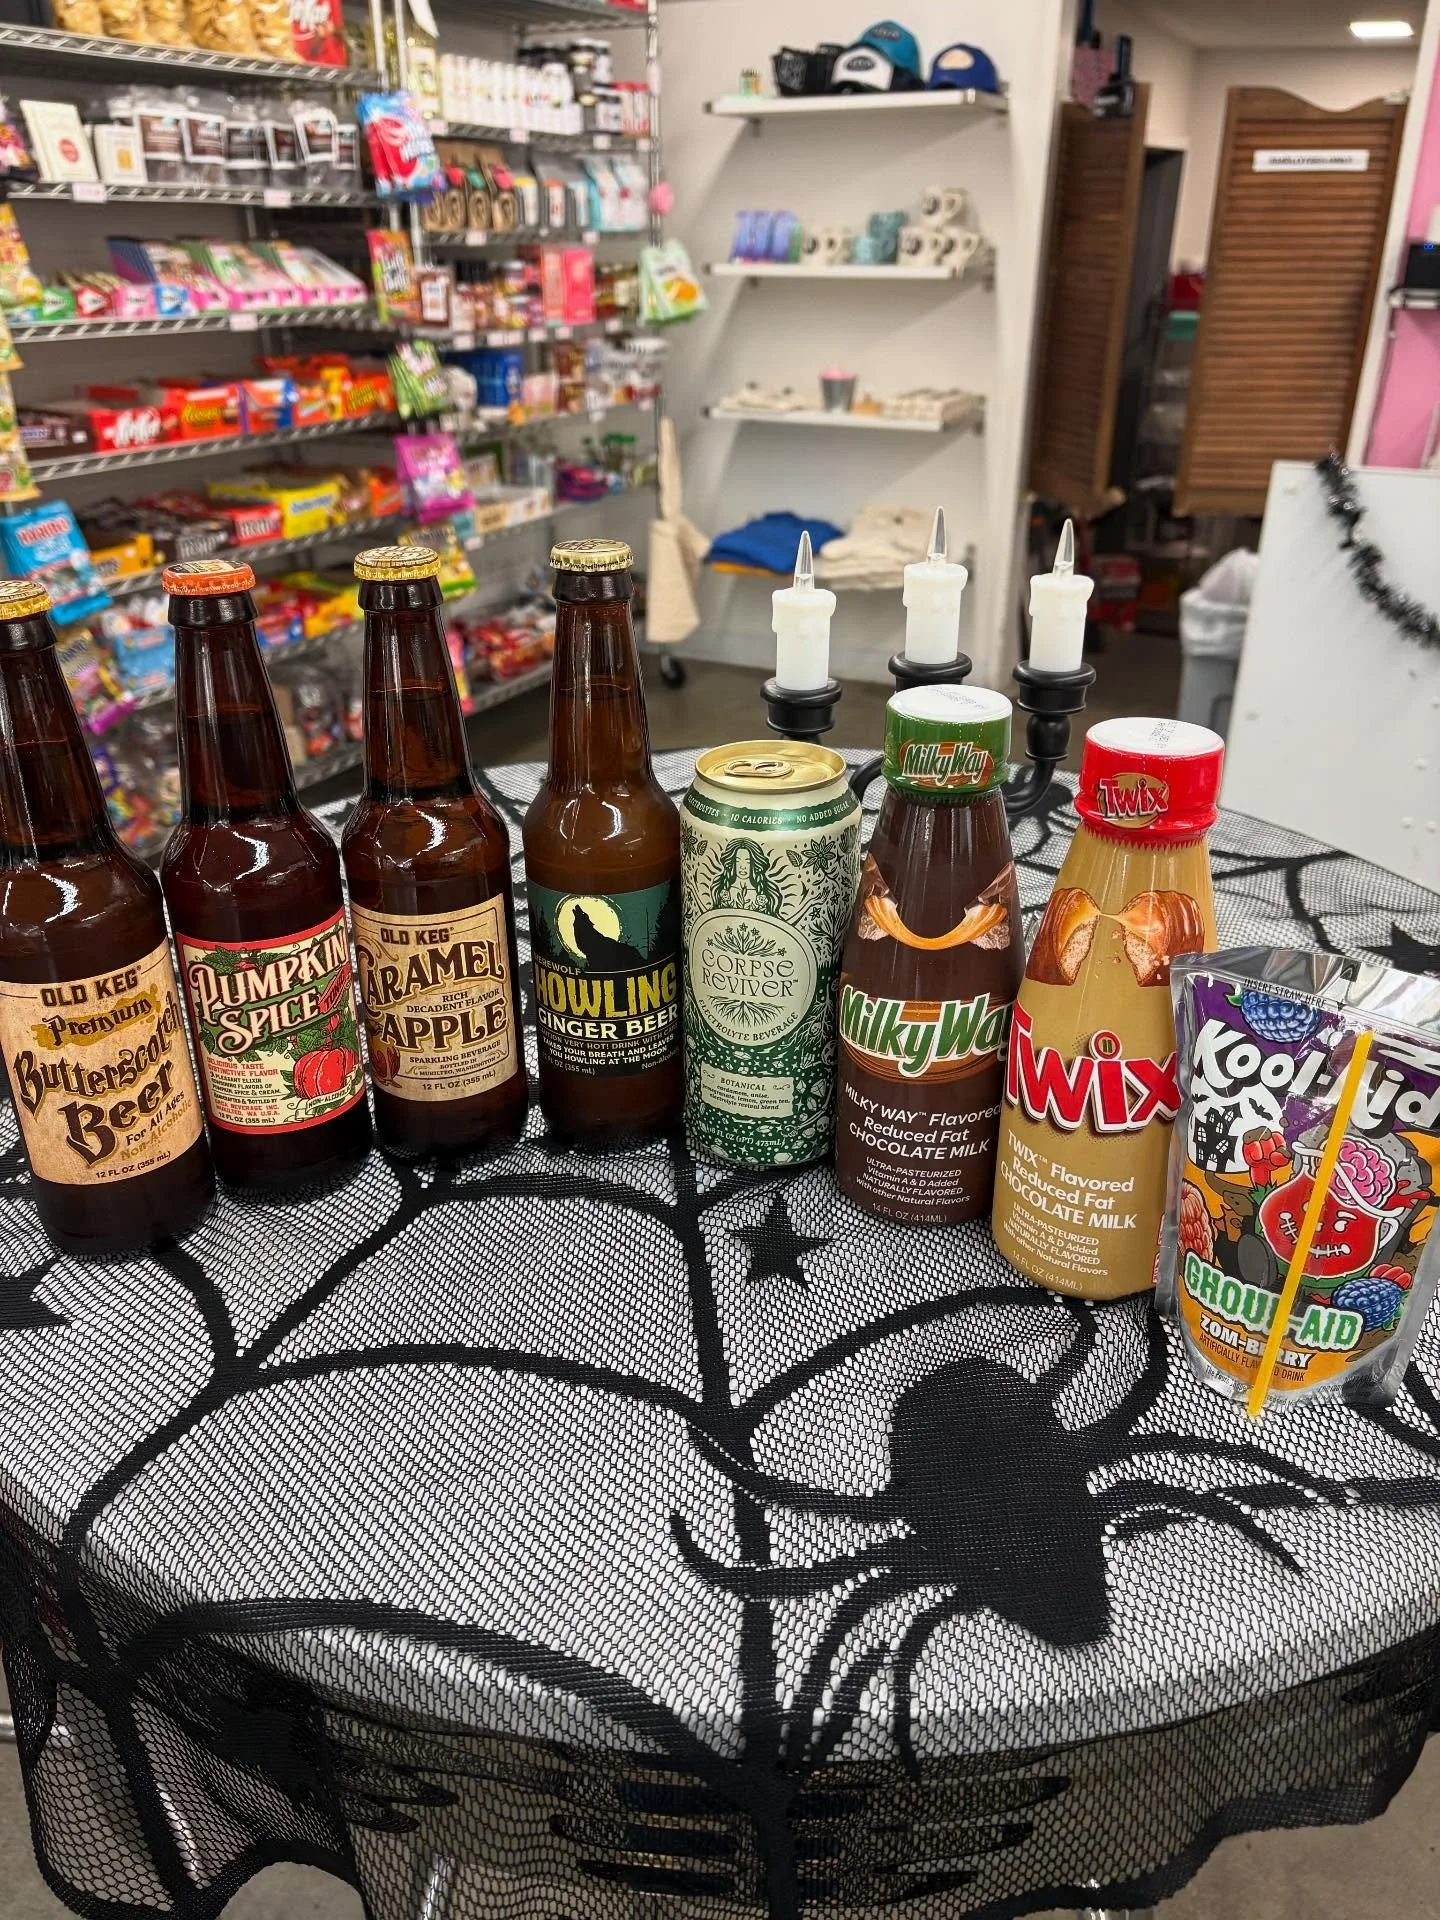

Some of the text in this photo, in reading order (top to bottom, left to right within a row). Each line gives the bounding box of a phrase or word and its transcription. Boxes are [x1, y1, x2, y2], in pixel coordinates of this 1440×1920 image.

[730, 813, 739, 822] 10
[742, 815, 783, 825] CALORIES
[796, 815, 807, 824] NO
[809, 809, 832, 822] ADDED
[833, 800, 850, 815] SUGAR
[1100, 777, 1170, 817] Twix
[380, 927, 410, 946] OLD
[187, 931, 348, 1026] PUMPKIN
[356, 940, 505, 1012] CARAMEL
[534, 962, 677, 1018] HOWLING
[40, 985, 88, 1007] OLD
[406, 988, 500, 1013] DECADENT FLAVOR
[442, 991, 468, 1003] RICH
[1244, 978, 1327, 1008] INSERT STRAW HERE
[42, 998, 153, 1046] Premium
[217, 987, 321, 1055] SPICE
[381, 999, 508, 1050] APPLE
[538, 1003, 679, 1040] GINGER BEER
[699, 999, 799, 1041] ELECTROLYTE BEVERAGE
[839, 985, 936, 1077] Milky
[13, 990, 184, 1119] Butterscotch
[409, 1039, 501, 1064] SPARKLING BEVERAGE
[549, 1047, 563, 1059] YOU
[564, 1054, 606, 1065] HOWLING
[622, 1055, 641, 1063] THE
[642, 1045, 668, 1060] MOON
[563, 1047, 586, 1057] YOUR
[627, 1046, 647, 1056] AND
[648, 1033, 674, 1051] LEAVES
[564, 1034, 663, 1050] VERY HOT! DRINK WITH
[249, 1069, 278, 1077] FLAVOR
[440, 1060, 470, 1070] BOTTLED
[455, 1057, 496, 1074] WASHINGTON
[463, 1077, 480, 1087] (355
[482, 1069, 496, 1080] mL)
[1006, 998, 1182, 1133] Twix
[720, 1077, 766, 1091] BOTANICAL
[845, 1082, 879, 1113] MILKY
[58, 1059, 173, 1167] Beer
[125, 1090, 185, 1146] For All Ages
[120, 1098, 193, 1161] Non-Alcoholic
[849, 1122, 991, 1160] CHOCOLATE MILK
[864, 1116, 970, 1144] Reduced Fat
[96, 1150, 171, 1179] 12 FL OZ (355 mL)
[866, 1156, 962, 1178] ULTRA-PASTEURIZED
[868, 1166, 900, 1183] Vitamin
[909, 1178, 917, 1186] &
[918, 1179, 927, 1187] D
[927, 1178, 959, 1187] Added
[1050, 1162, 1135, 1192] Flavored
[856, 1176, 971, 1205] With other Natural Flavors
[863, 1172, 964, 1196] NATURALLY FLAVORED
[1001, 1160, 1138, 1229] CHOCOLATE MILK
[1012, 1155, 1115, 1210] Reduced Fat
[872, 1202, 947, 1223] 14 FL OZ (414ML)
[1013, 1201, 1100, 1246] ULTRA-PASTEURIZED
[1008, 1217, 1100, 1265] NATURALLY FLAVORED
[1012, 1209, 1099, 1256] Vitamin A & D Added
[1016, 1236, 1036, 1253] other
[1036, 1249, 1071, 1269] Natural
[1071, 1263, 1109, 1276] Flavors
[1020, 1257, 1030, 1270] FL
[1031, 1265, 1044, 1277] OZ
[1045, 1272, 1083, 1291] (414ML)
[1199, 1333, 1305, 1382] ARTIFICIALLY FLAVD DRINK
